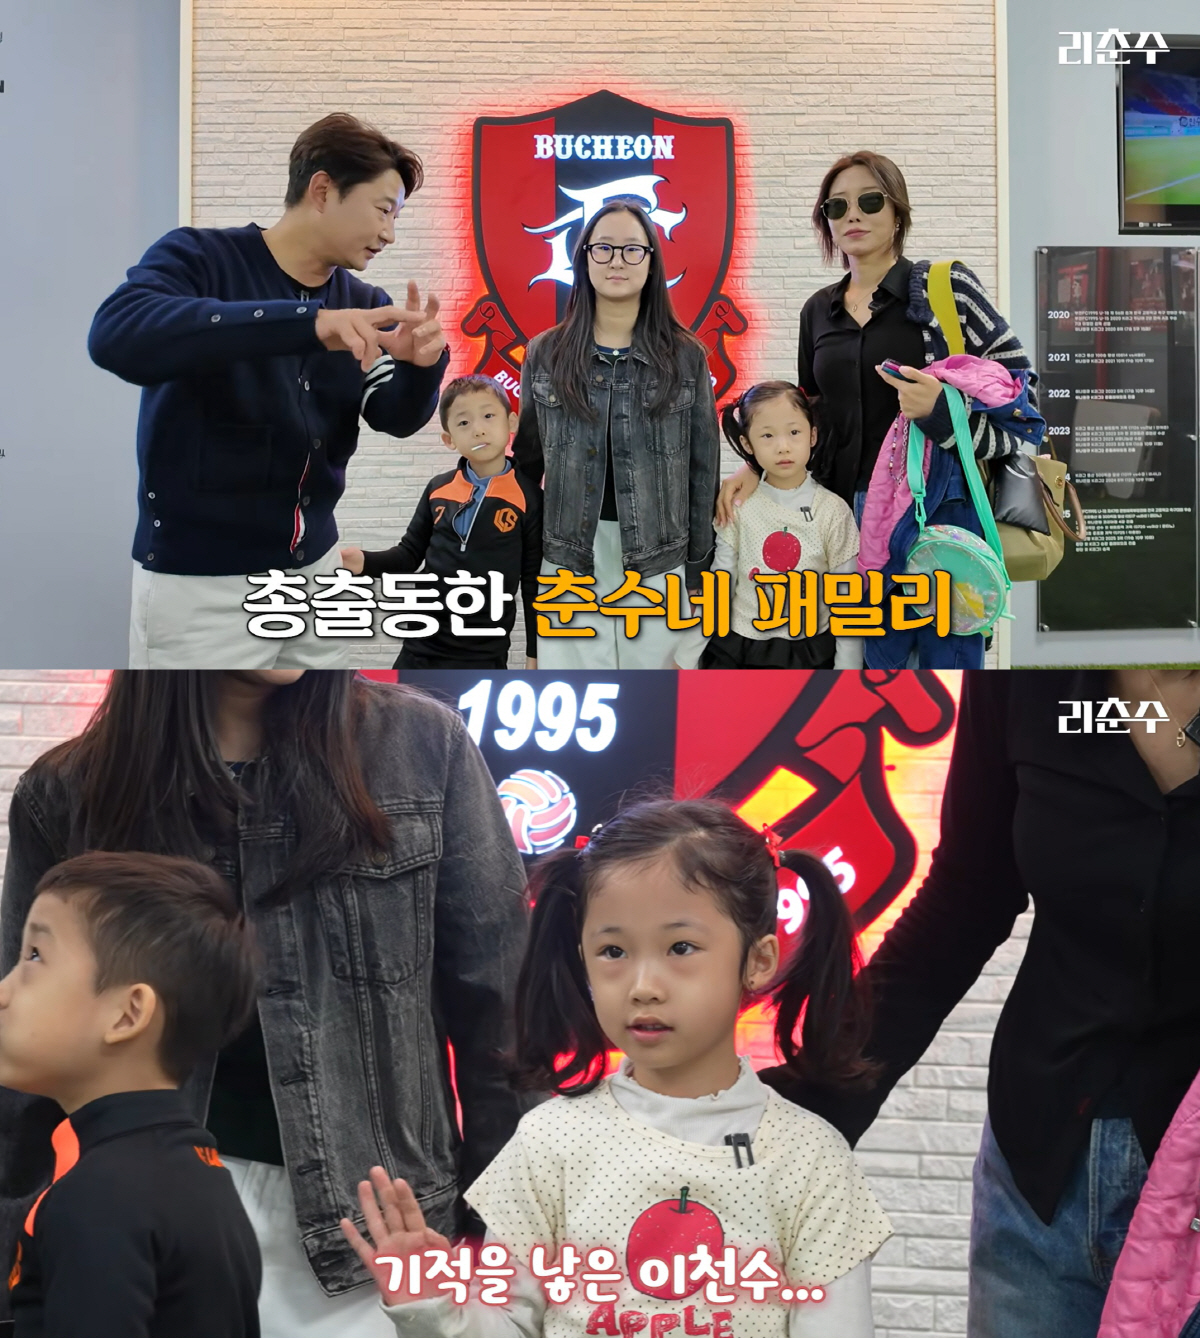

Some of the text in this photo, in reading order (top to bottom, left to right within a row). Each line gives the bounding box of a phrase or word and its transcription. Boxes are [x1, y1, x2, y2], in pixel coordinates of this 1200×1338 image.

[533, 134, 675, 160] BUCHEON
[1048, 310, 1070, 319] 2020
[1048, 353, 1070, 362] 2021
[1048, 389, 1070, 398] 2022
[1049, 426, 1070, 435] 2023
[459, 679, 620, 752] 1995
[586, 1303, 734, 1338] APPLE
